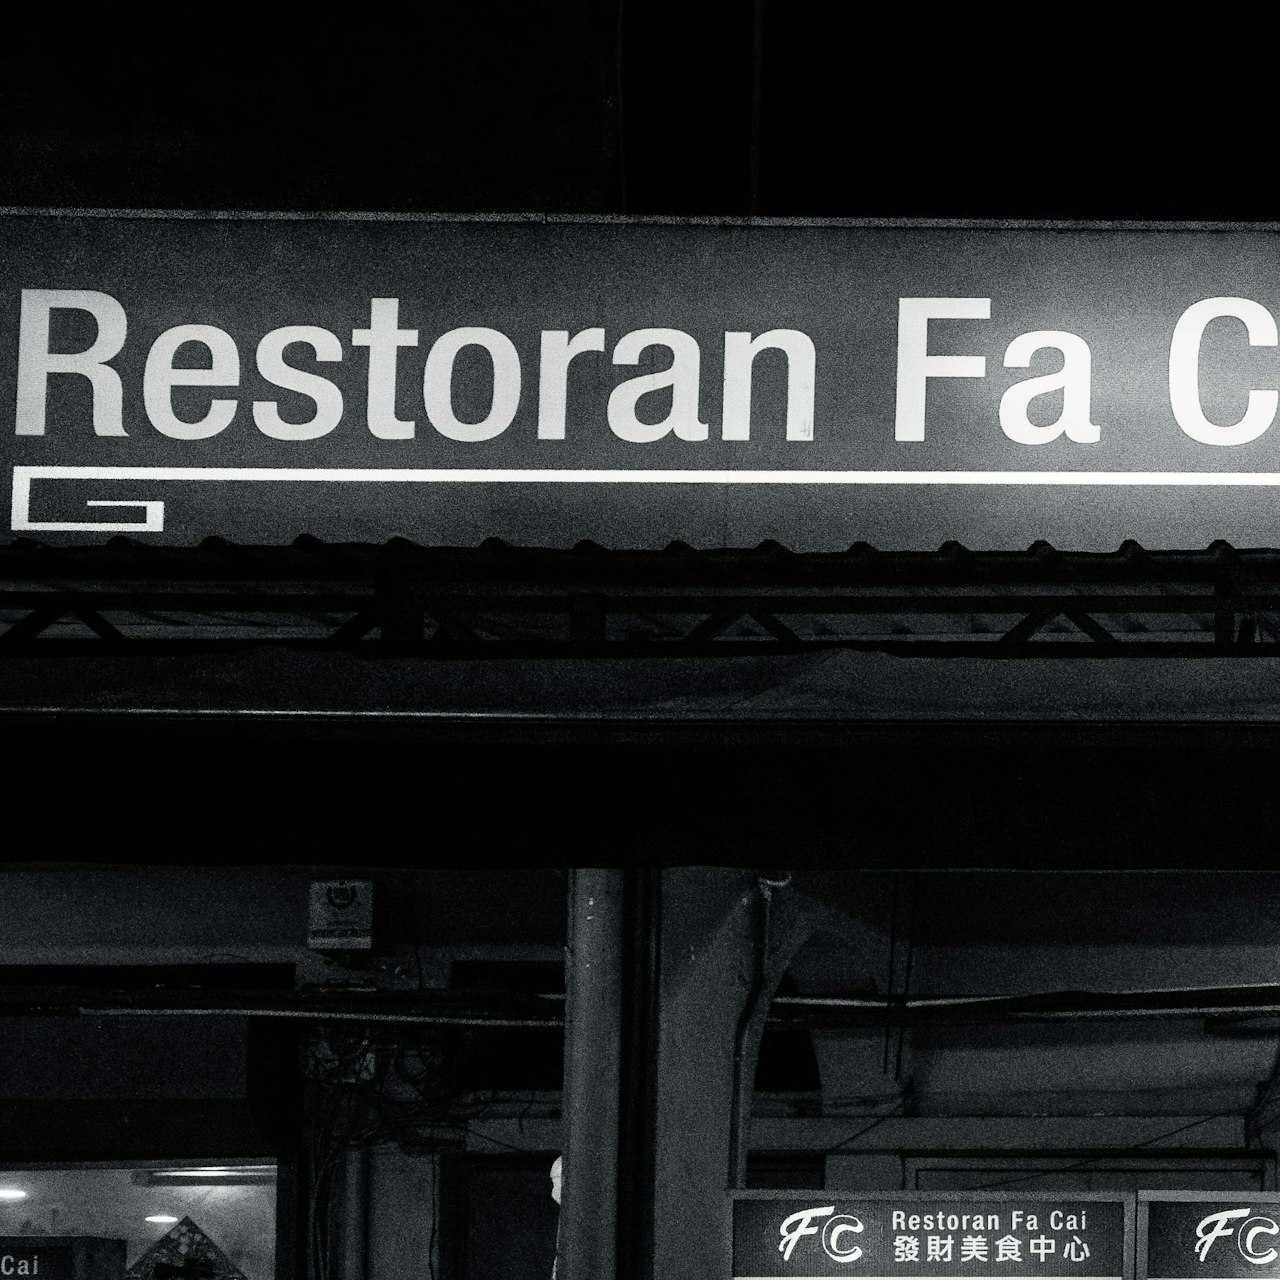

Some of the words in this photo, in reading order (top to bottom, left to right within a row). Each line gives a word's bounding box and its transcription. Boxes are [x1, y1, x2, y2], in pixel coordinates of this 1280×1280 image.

[13, 287, 816, 443] Restoran
[894, 296, 1101, 447] Fa
[892, 1211, 1000, 1231] Restoran
[1011, 1211, 1038, 1231] Fa
[1050, 1211, 1087, 1231] Cai
[893, 1235, 1090, 1262] 發財美食中心
